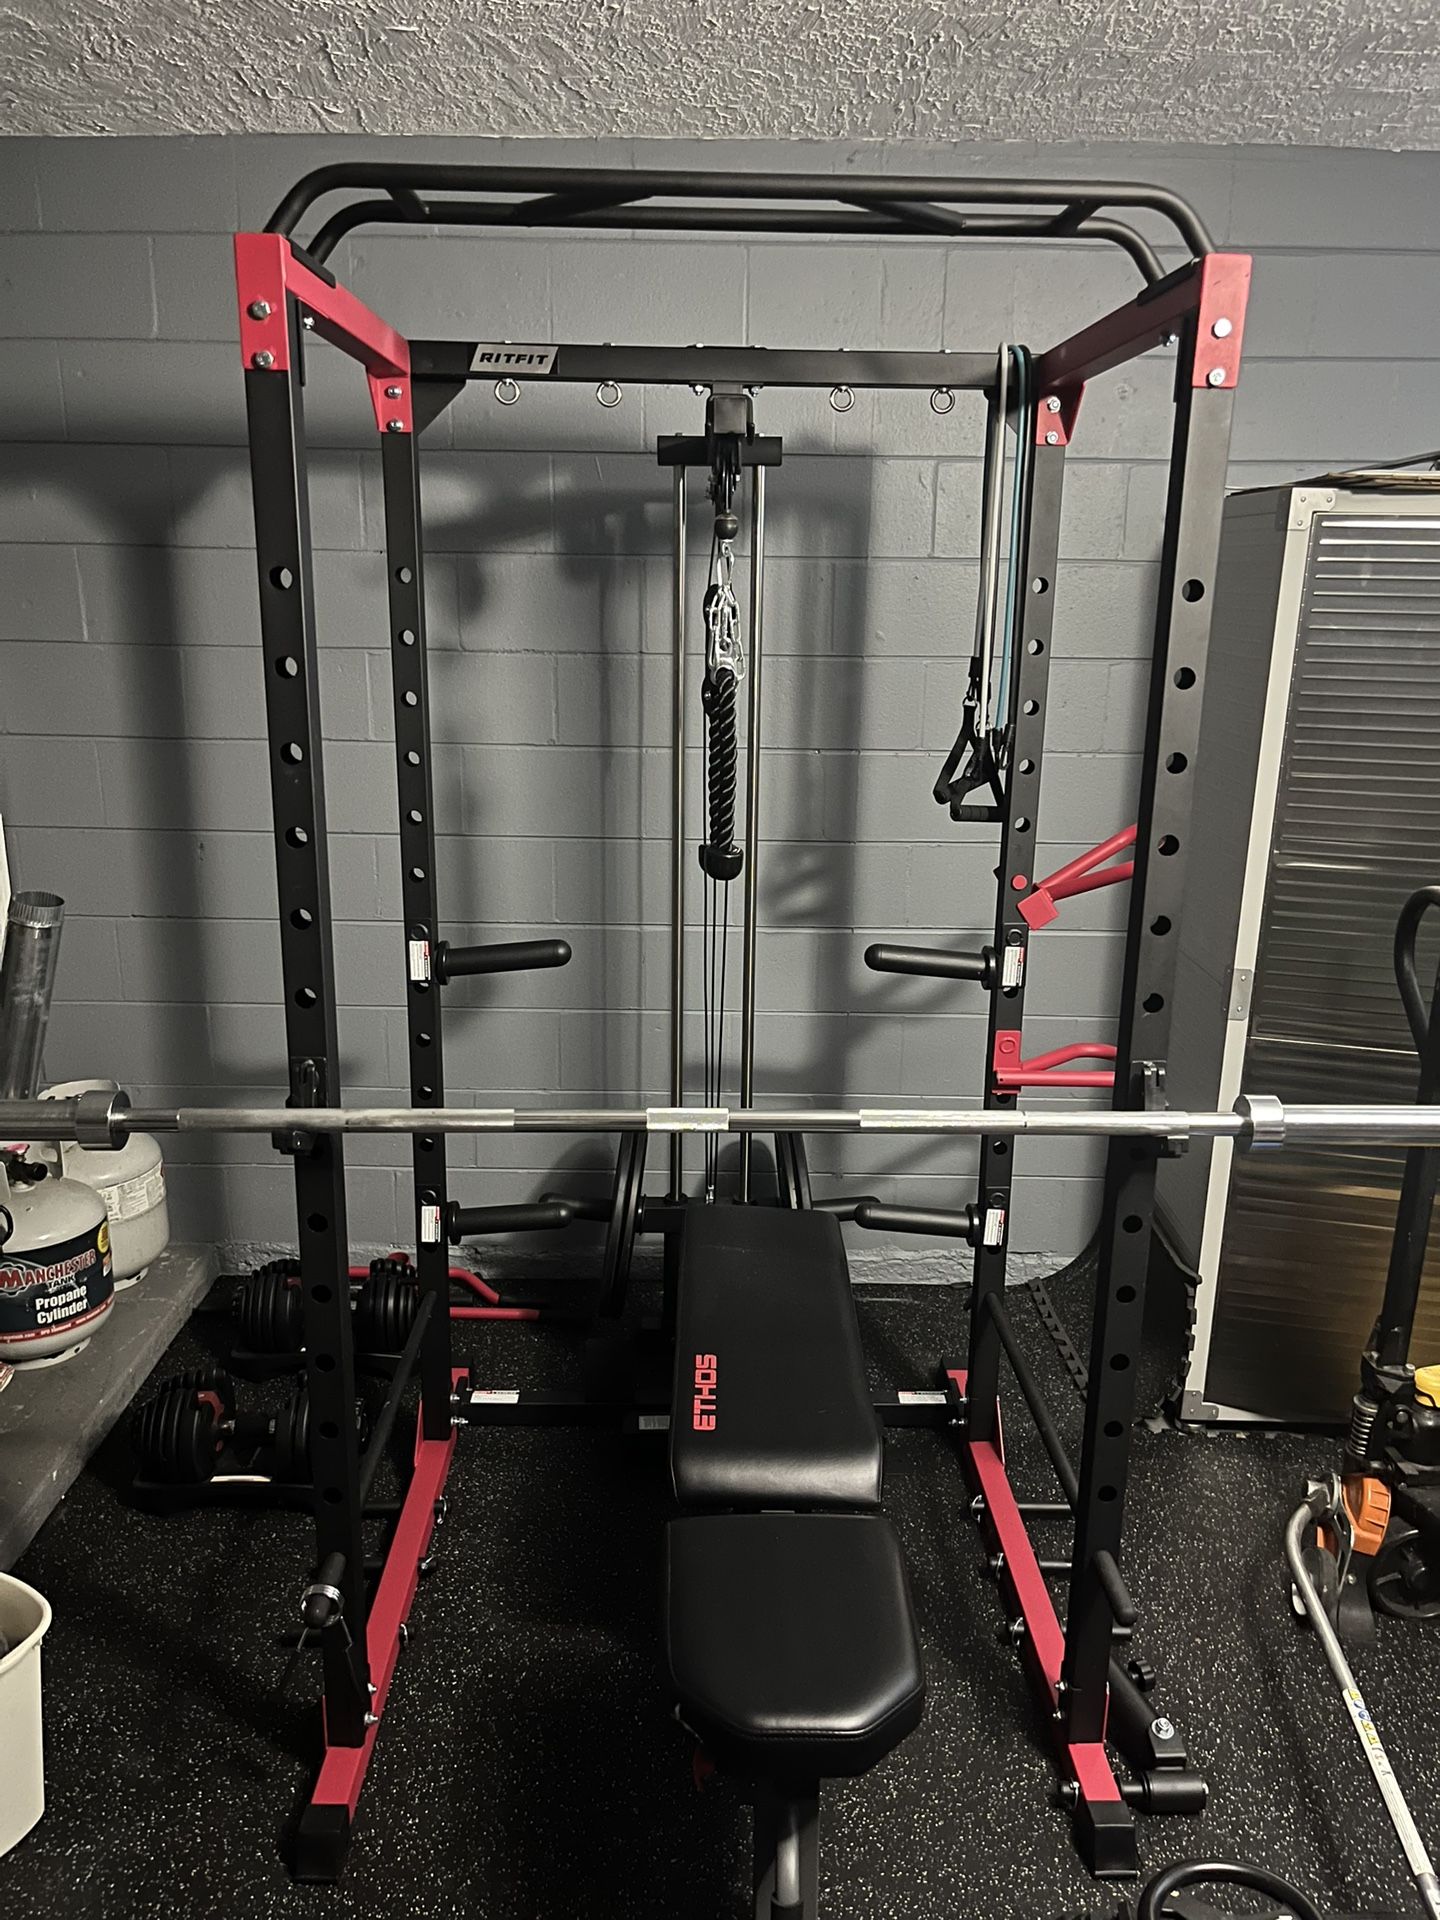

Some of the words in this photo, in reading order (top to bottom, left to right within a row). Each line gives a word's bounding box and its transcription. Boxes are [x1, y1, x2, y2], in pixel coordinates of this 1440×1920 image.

[479, 352, 549, 365] RITFIT
[0, 1249, 97, 1289] MANCHESTER
[47, 1274, 75, 1289] TANK
[35, 1285, 87, 1311] Propane
[37, 1299, 88, 1324] Cylinder
[693, 1354, 717, 1431] ETHOS
